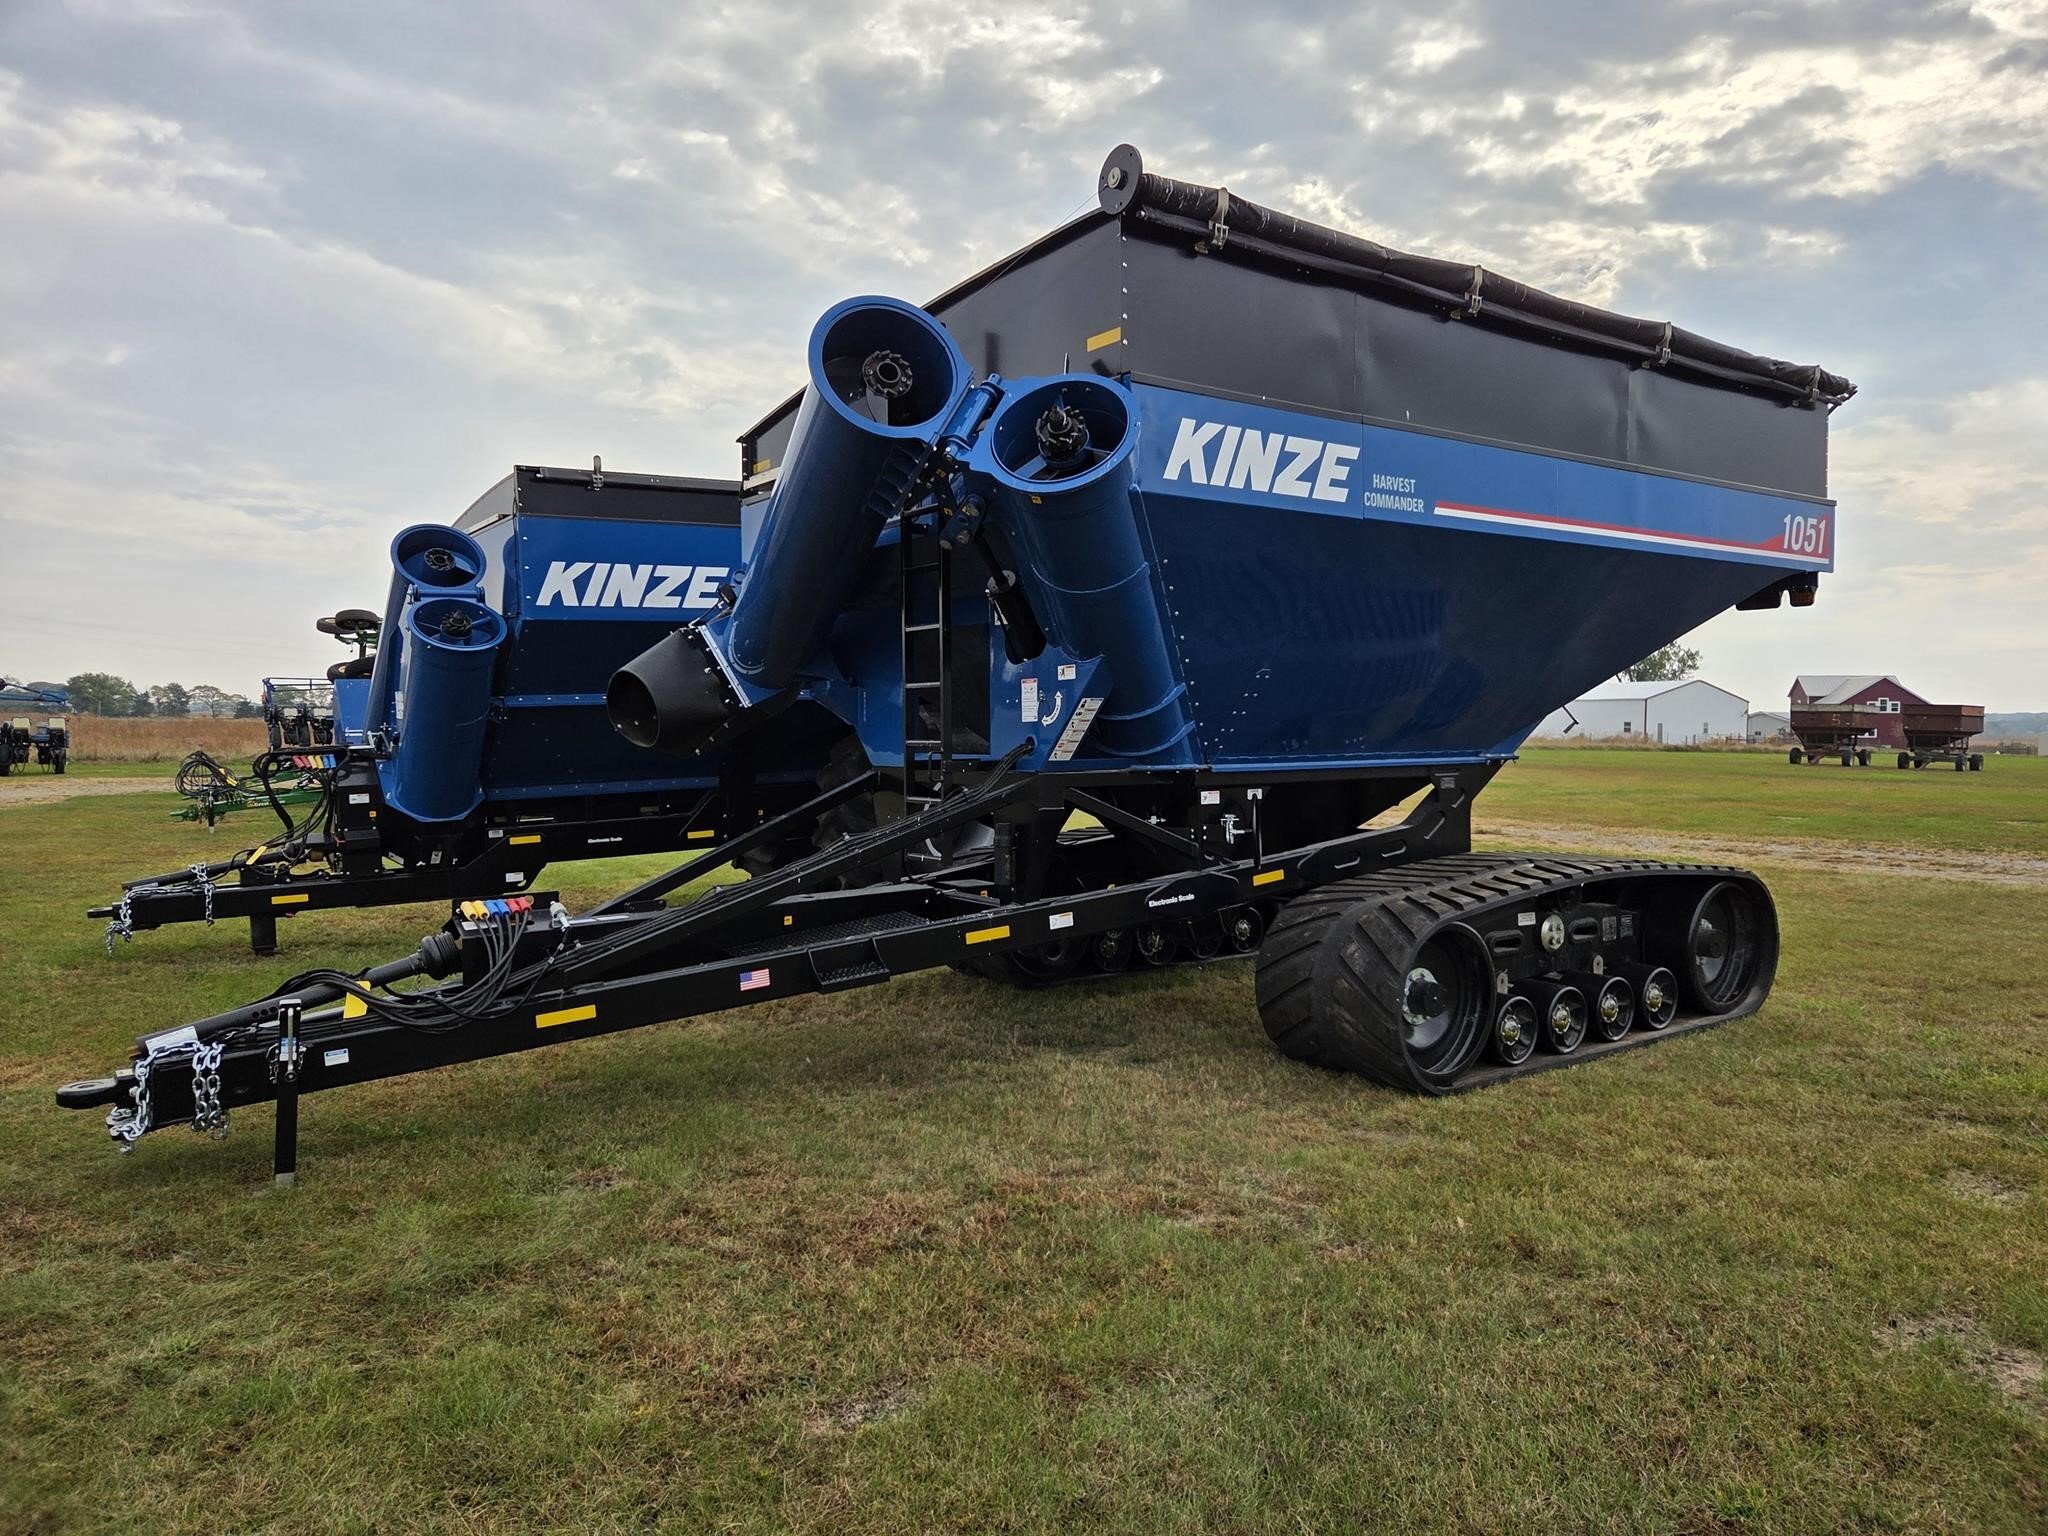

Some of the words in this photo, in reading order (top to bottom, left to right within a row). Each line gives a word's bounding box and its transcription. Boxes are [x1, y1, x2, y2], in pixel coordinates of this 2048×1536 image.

[1163, 417, 1360, 502] KINZE
[1364, 491, 1424, 513] COMMANDER
[1373, 473, 1416, 493] HARVEST
[1783, 513, 1826, 554] 1051
[536, 561, 730, 608] KINZE
